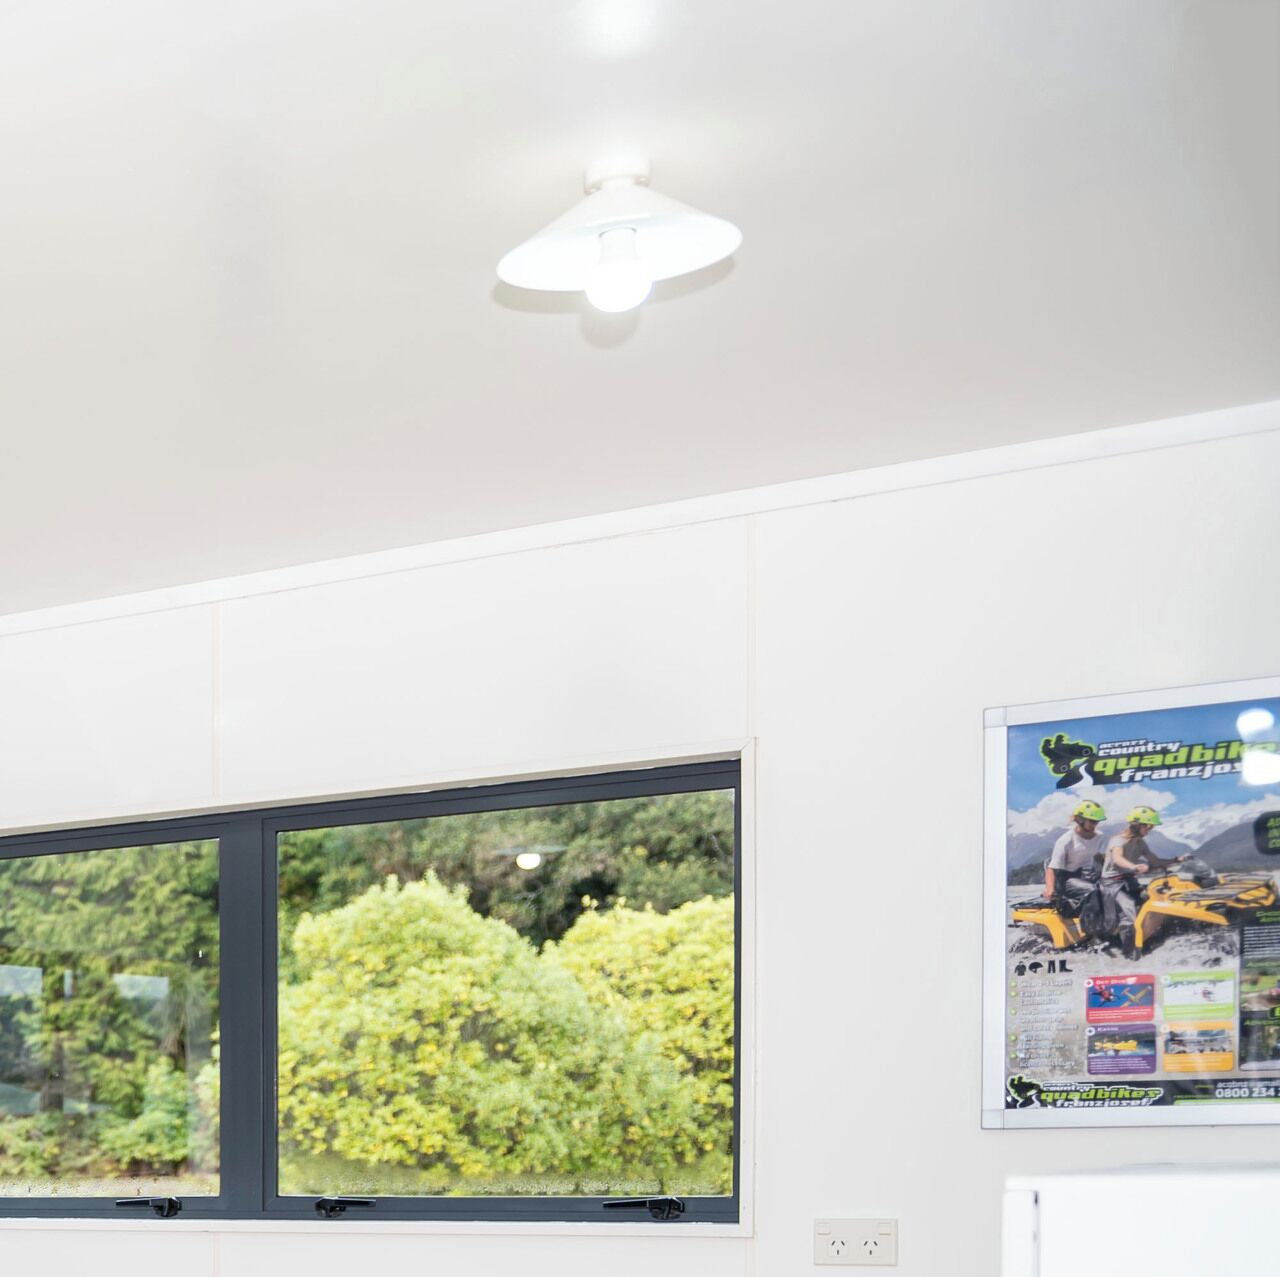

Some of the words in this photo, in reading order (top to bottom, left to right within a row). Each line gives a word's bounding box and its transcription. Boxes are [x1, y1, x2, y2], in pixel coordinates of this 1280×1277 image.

[1098, 741, 1181, 757] country
[1041, 1088, 1161, 1102] quadbikes
[1215, 1088, 1250, 1098] 0800
[1251, 1087, 1275, 1097] 234
